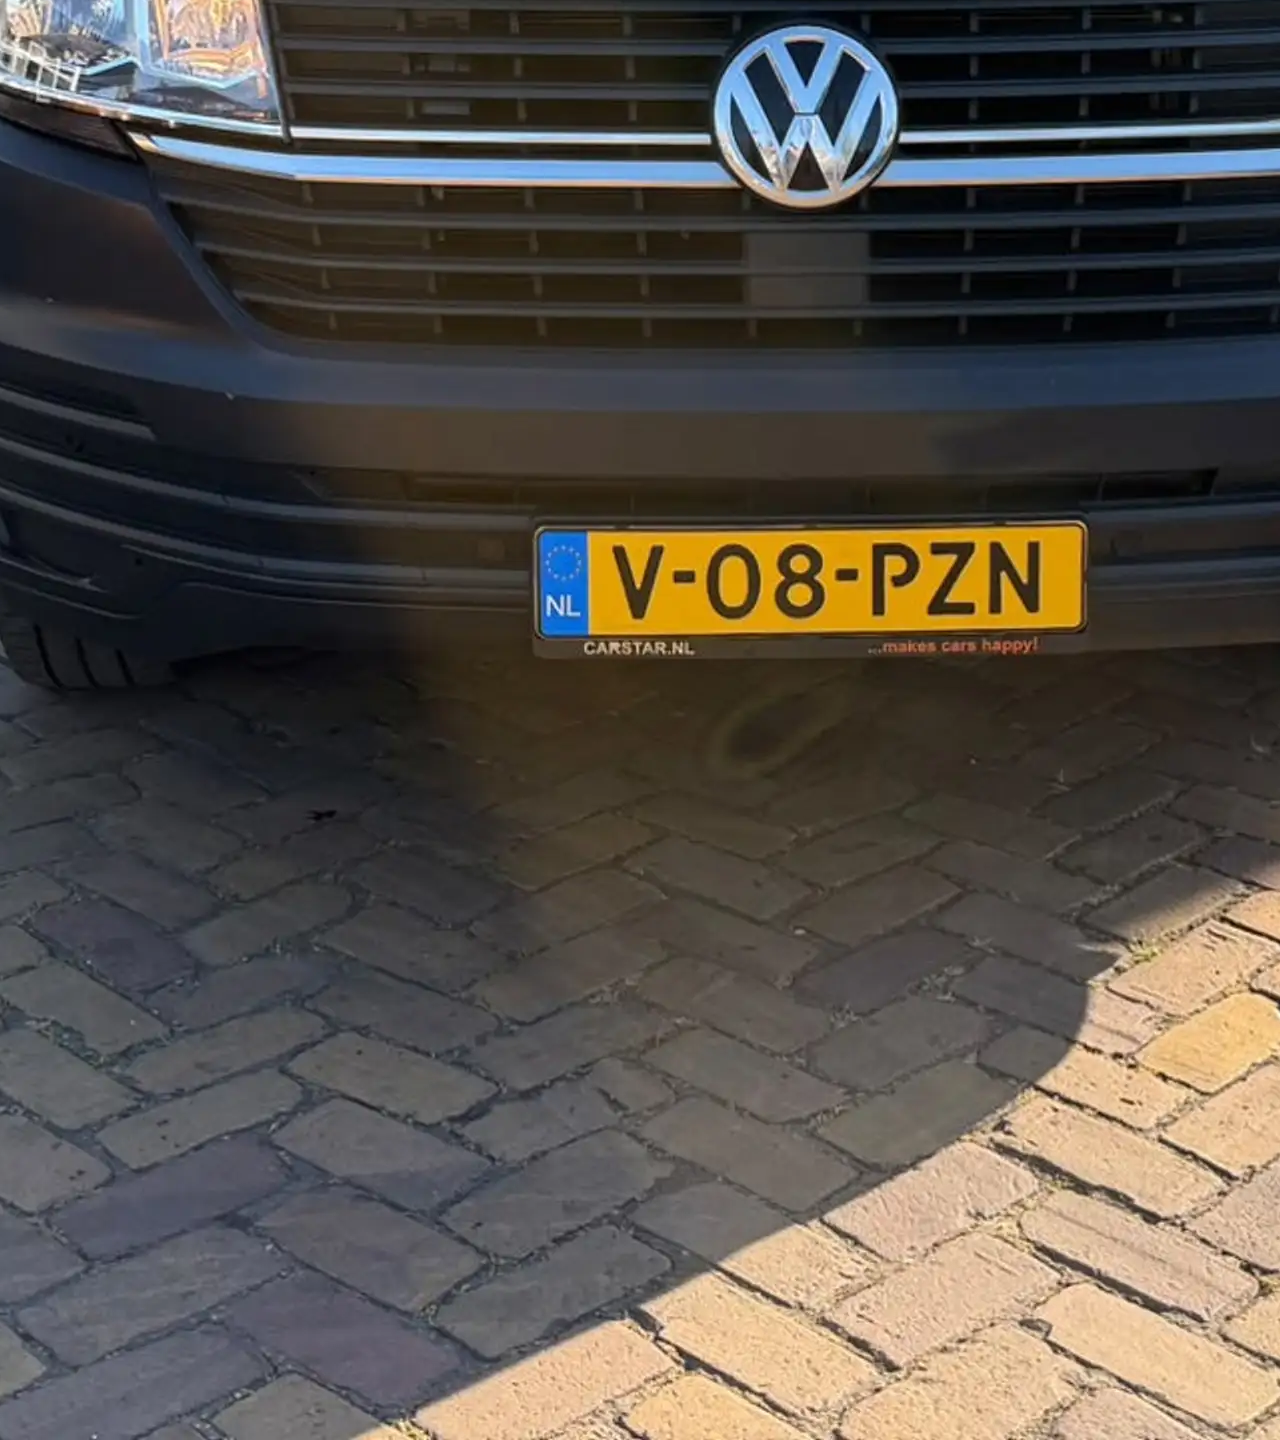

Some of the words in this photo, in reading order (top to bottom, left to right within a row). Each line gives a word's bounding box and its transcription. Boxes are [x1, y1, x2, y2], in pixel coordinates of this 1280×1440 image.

[612, 540, 1041, 621] V-08-PZN
[545, 594, 582, 618] NL
[583, 640, 695, 656] CARSTAR.NL
[941, 639, 977, 654] cars
[980, 636, 1039, 656] happy!
